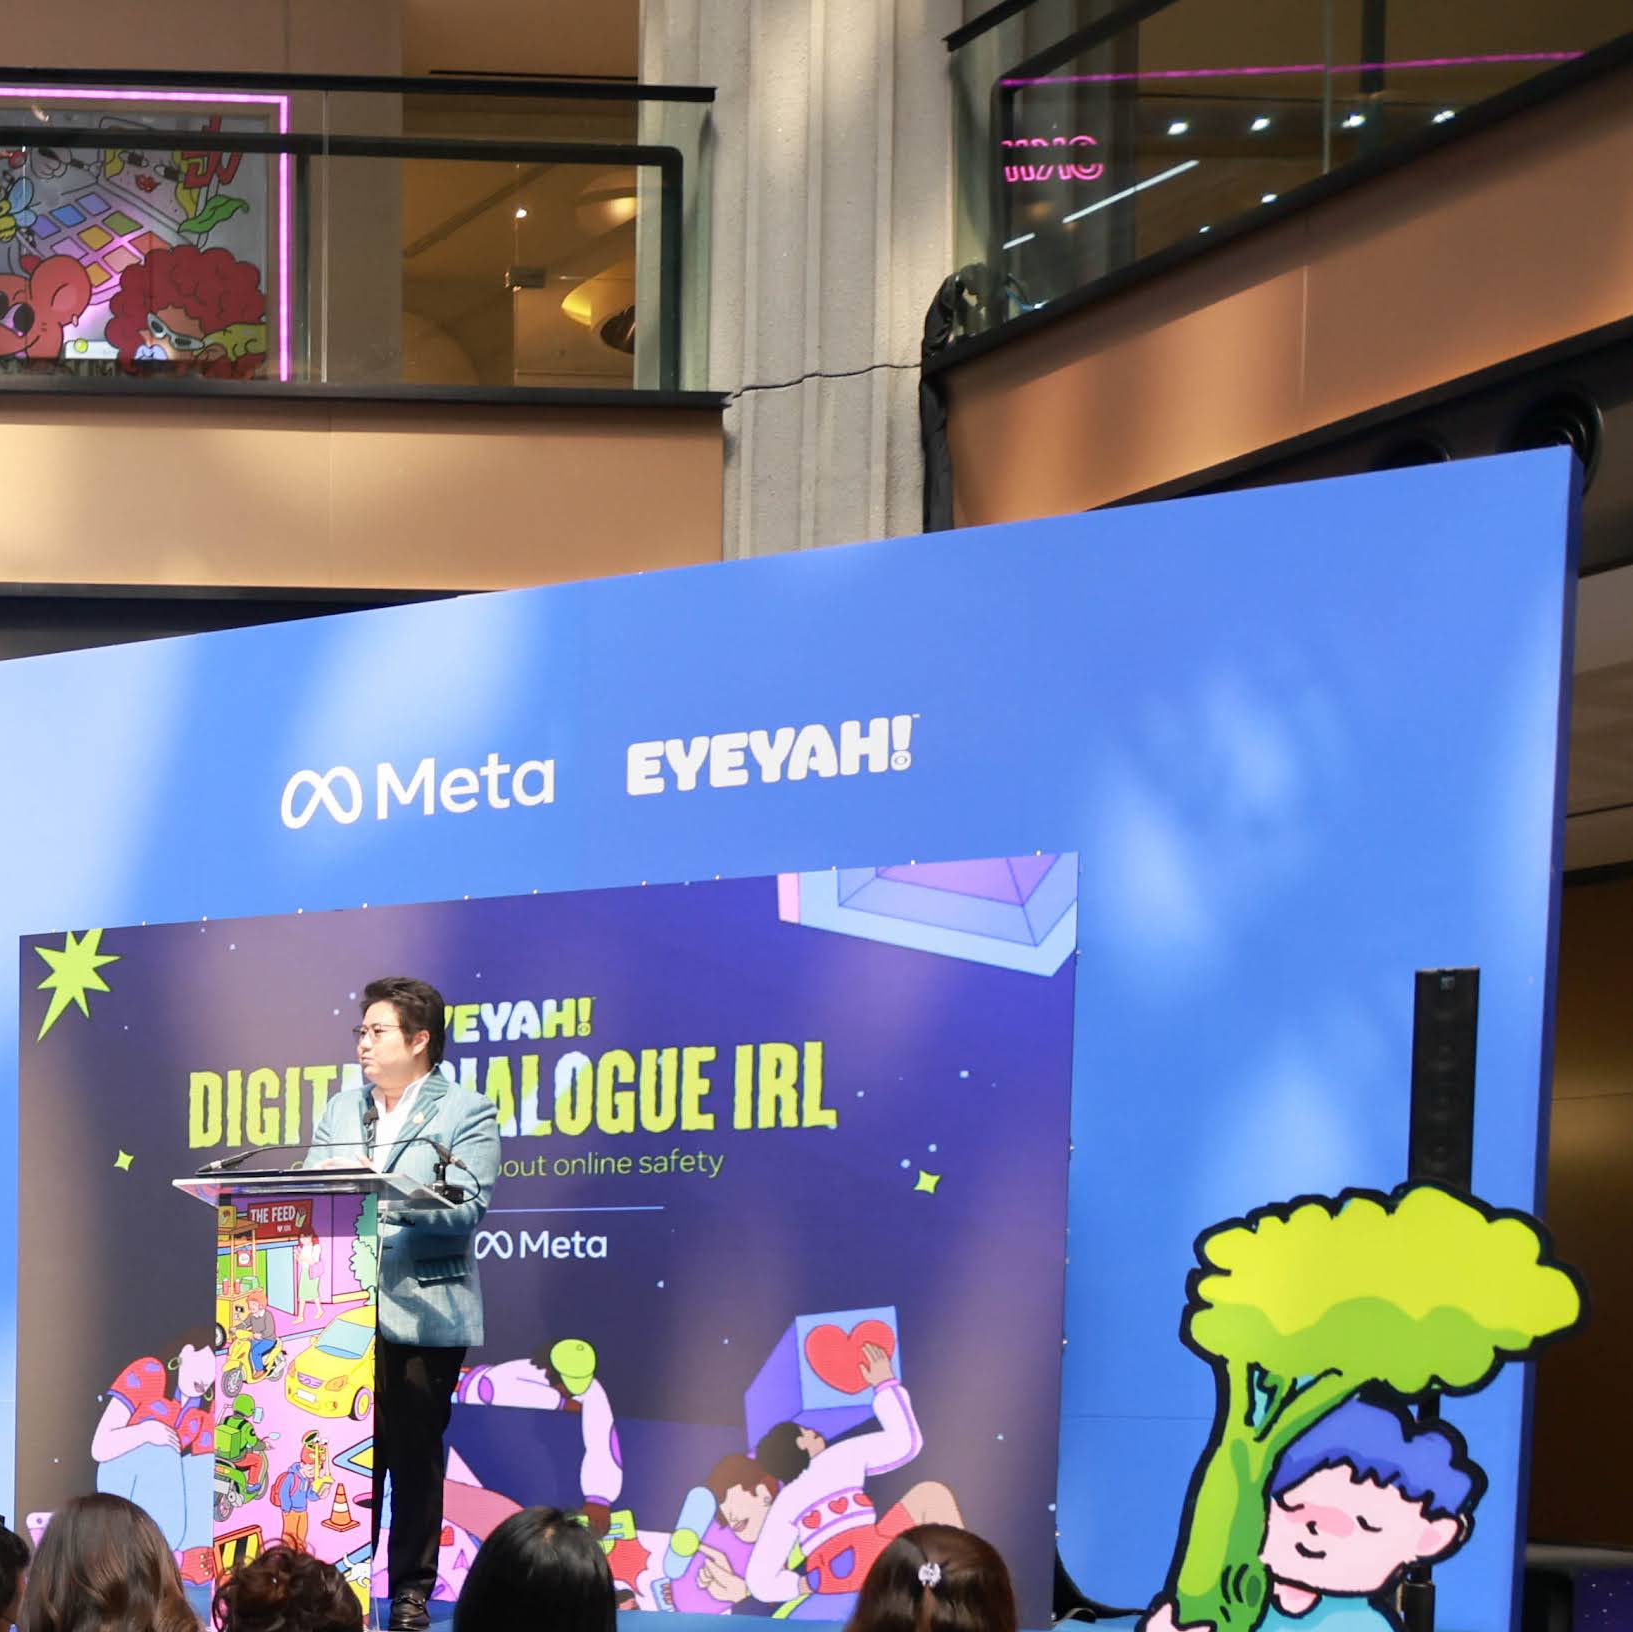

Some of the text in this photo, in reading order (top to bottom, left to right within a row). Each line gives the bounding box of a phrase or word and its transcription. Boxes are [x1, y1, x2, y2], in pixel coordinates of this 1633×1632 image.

[375, 714, 913, 821] Meta EYEYAH!
[444, 996, 592, 1044] EYAH!
[187, 1062, 363, 1149] DIGIT
[733, 1040, 837, 1131] IRL
[497, 1147, 725, 1180] out online safety
[250, 1204, 296, 1224] THE FEED
[519, 1229, 608, 1259] Meta
